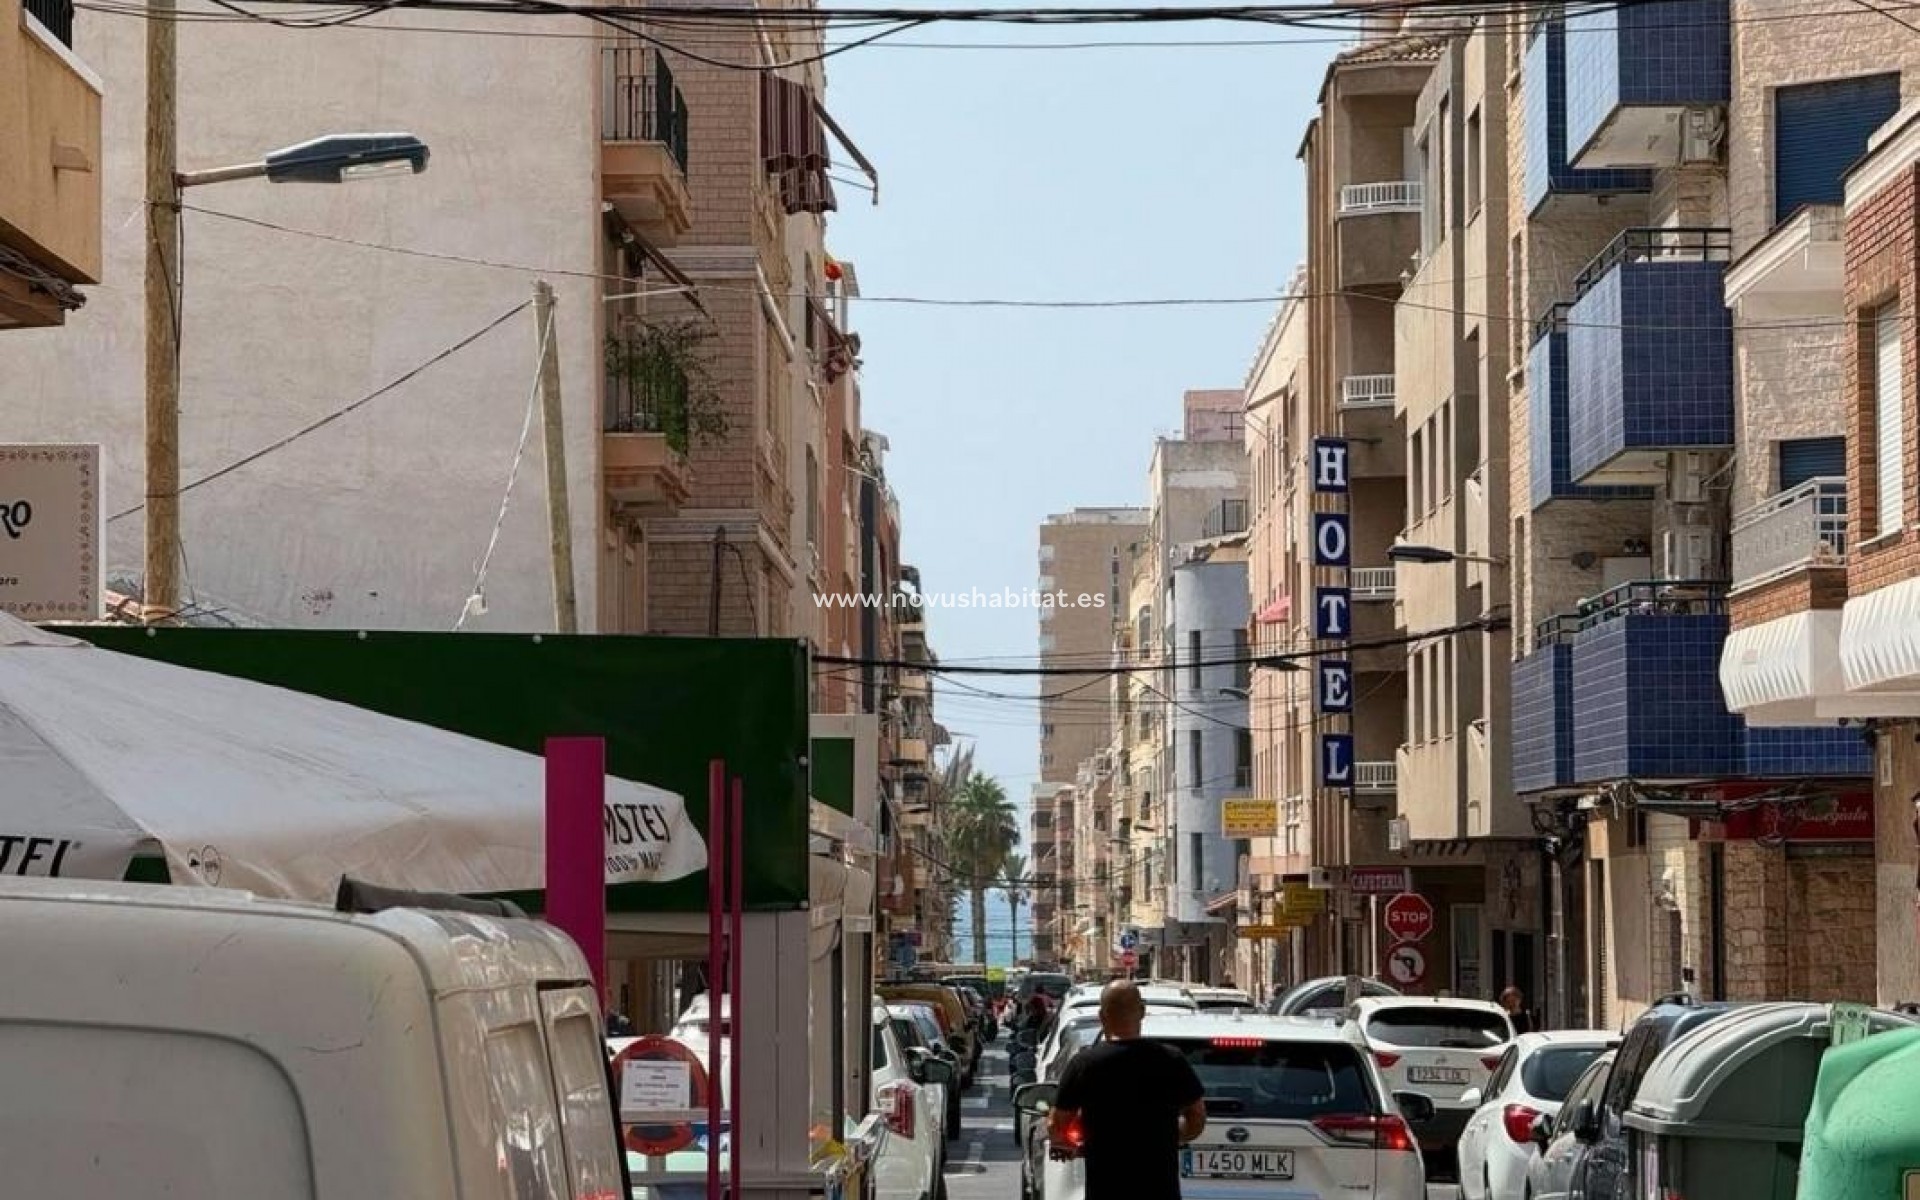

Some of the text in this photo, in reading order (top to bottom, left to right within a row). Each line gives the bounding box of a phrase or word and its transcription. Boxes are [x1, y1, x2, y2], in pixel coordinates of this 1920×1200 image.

[1317, 446, 1349, 780] HOTEL
[1391, 911, 1429, 924] STOP
[1197, 1152, 1288, 1173] 1450 MLK
